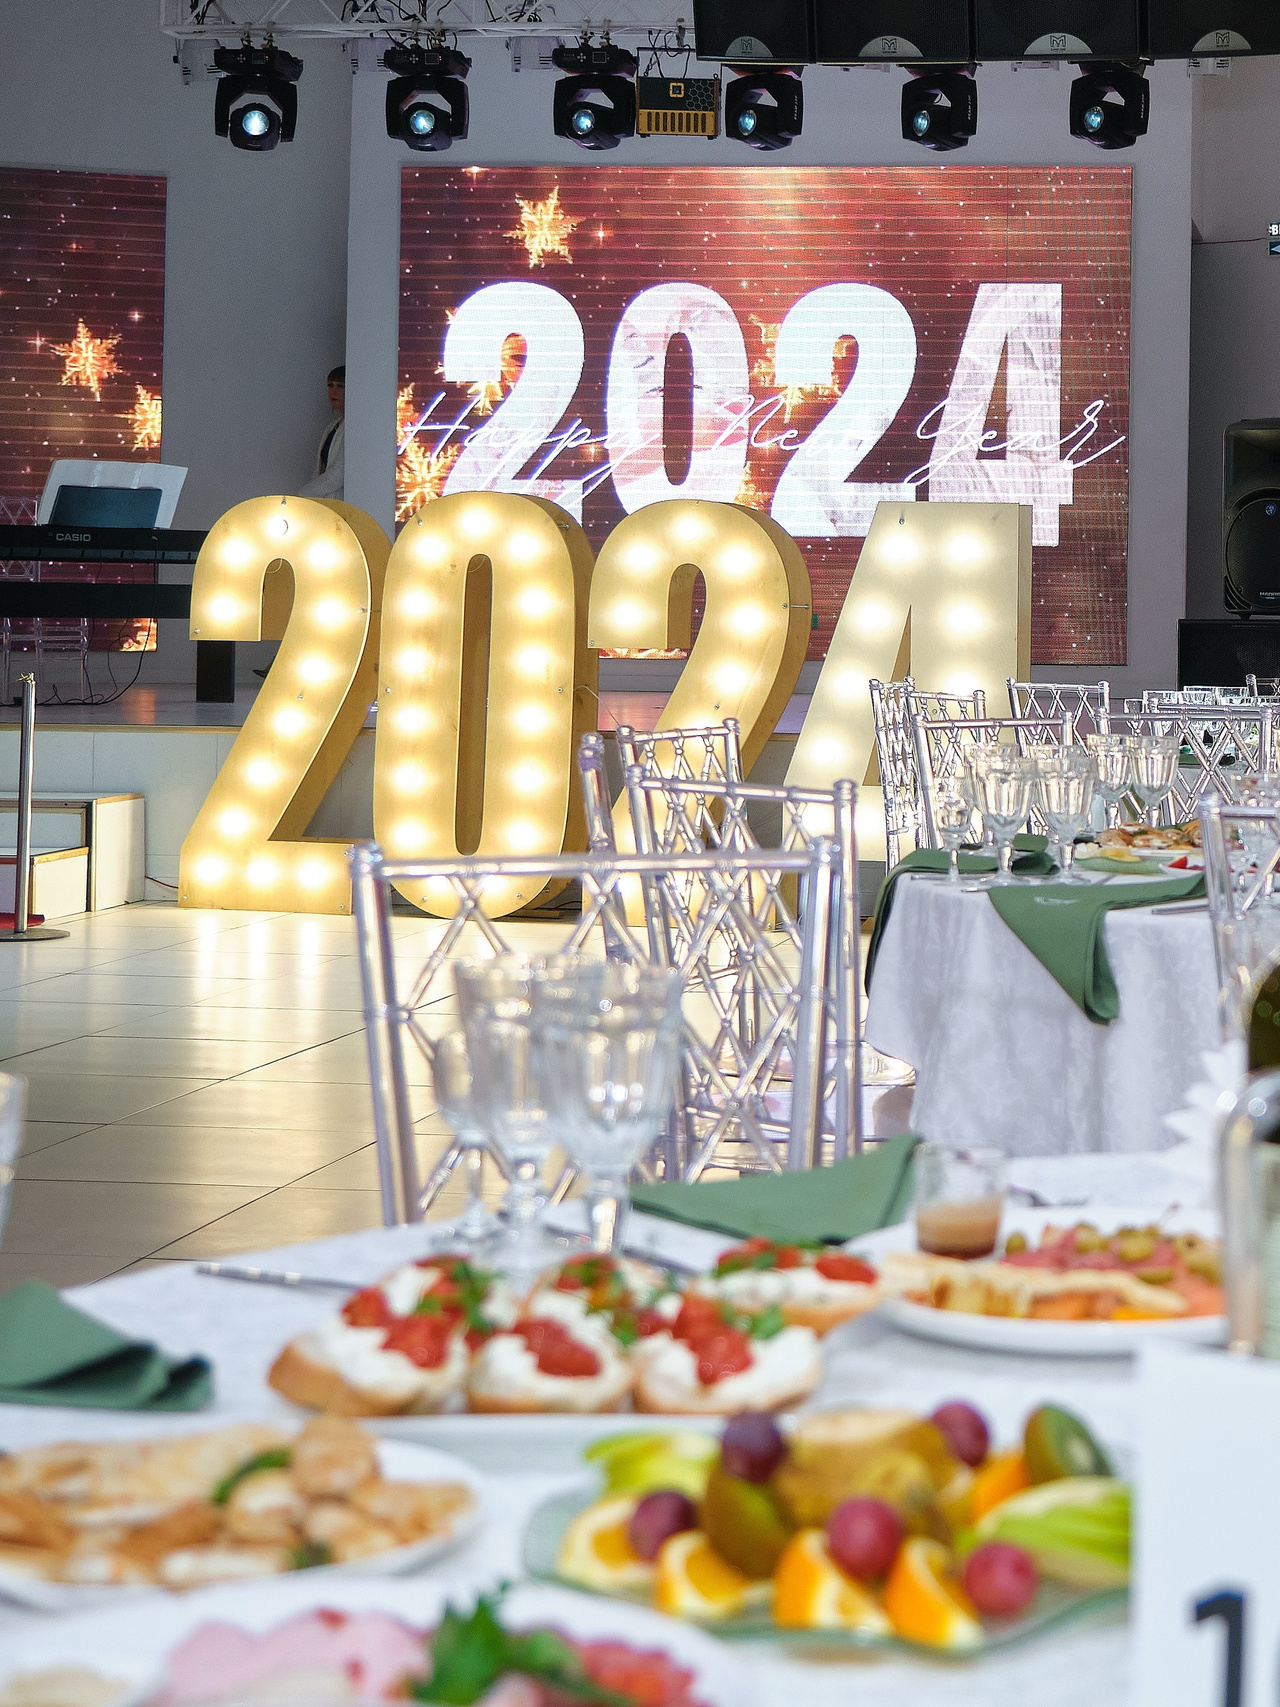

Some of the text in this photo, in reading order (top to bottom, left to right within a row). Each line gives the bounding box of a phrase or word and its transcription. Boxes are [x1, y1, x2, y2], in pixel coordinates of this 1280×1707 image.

[398, 390, 1126, 508] Happy New Year
[442, 281, 1074, 547] 2024
[56, 533, 91, 541] CASIO
[179, 490, 1032, 920] 2024
